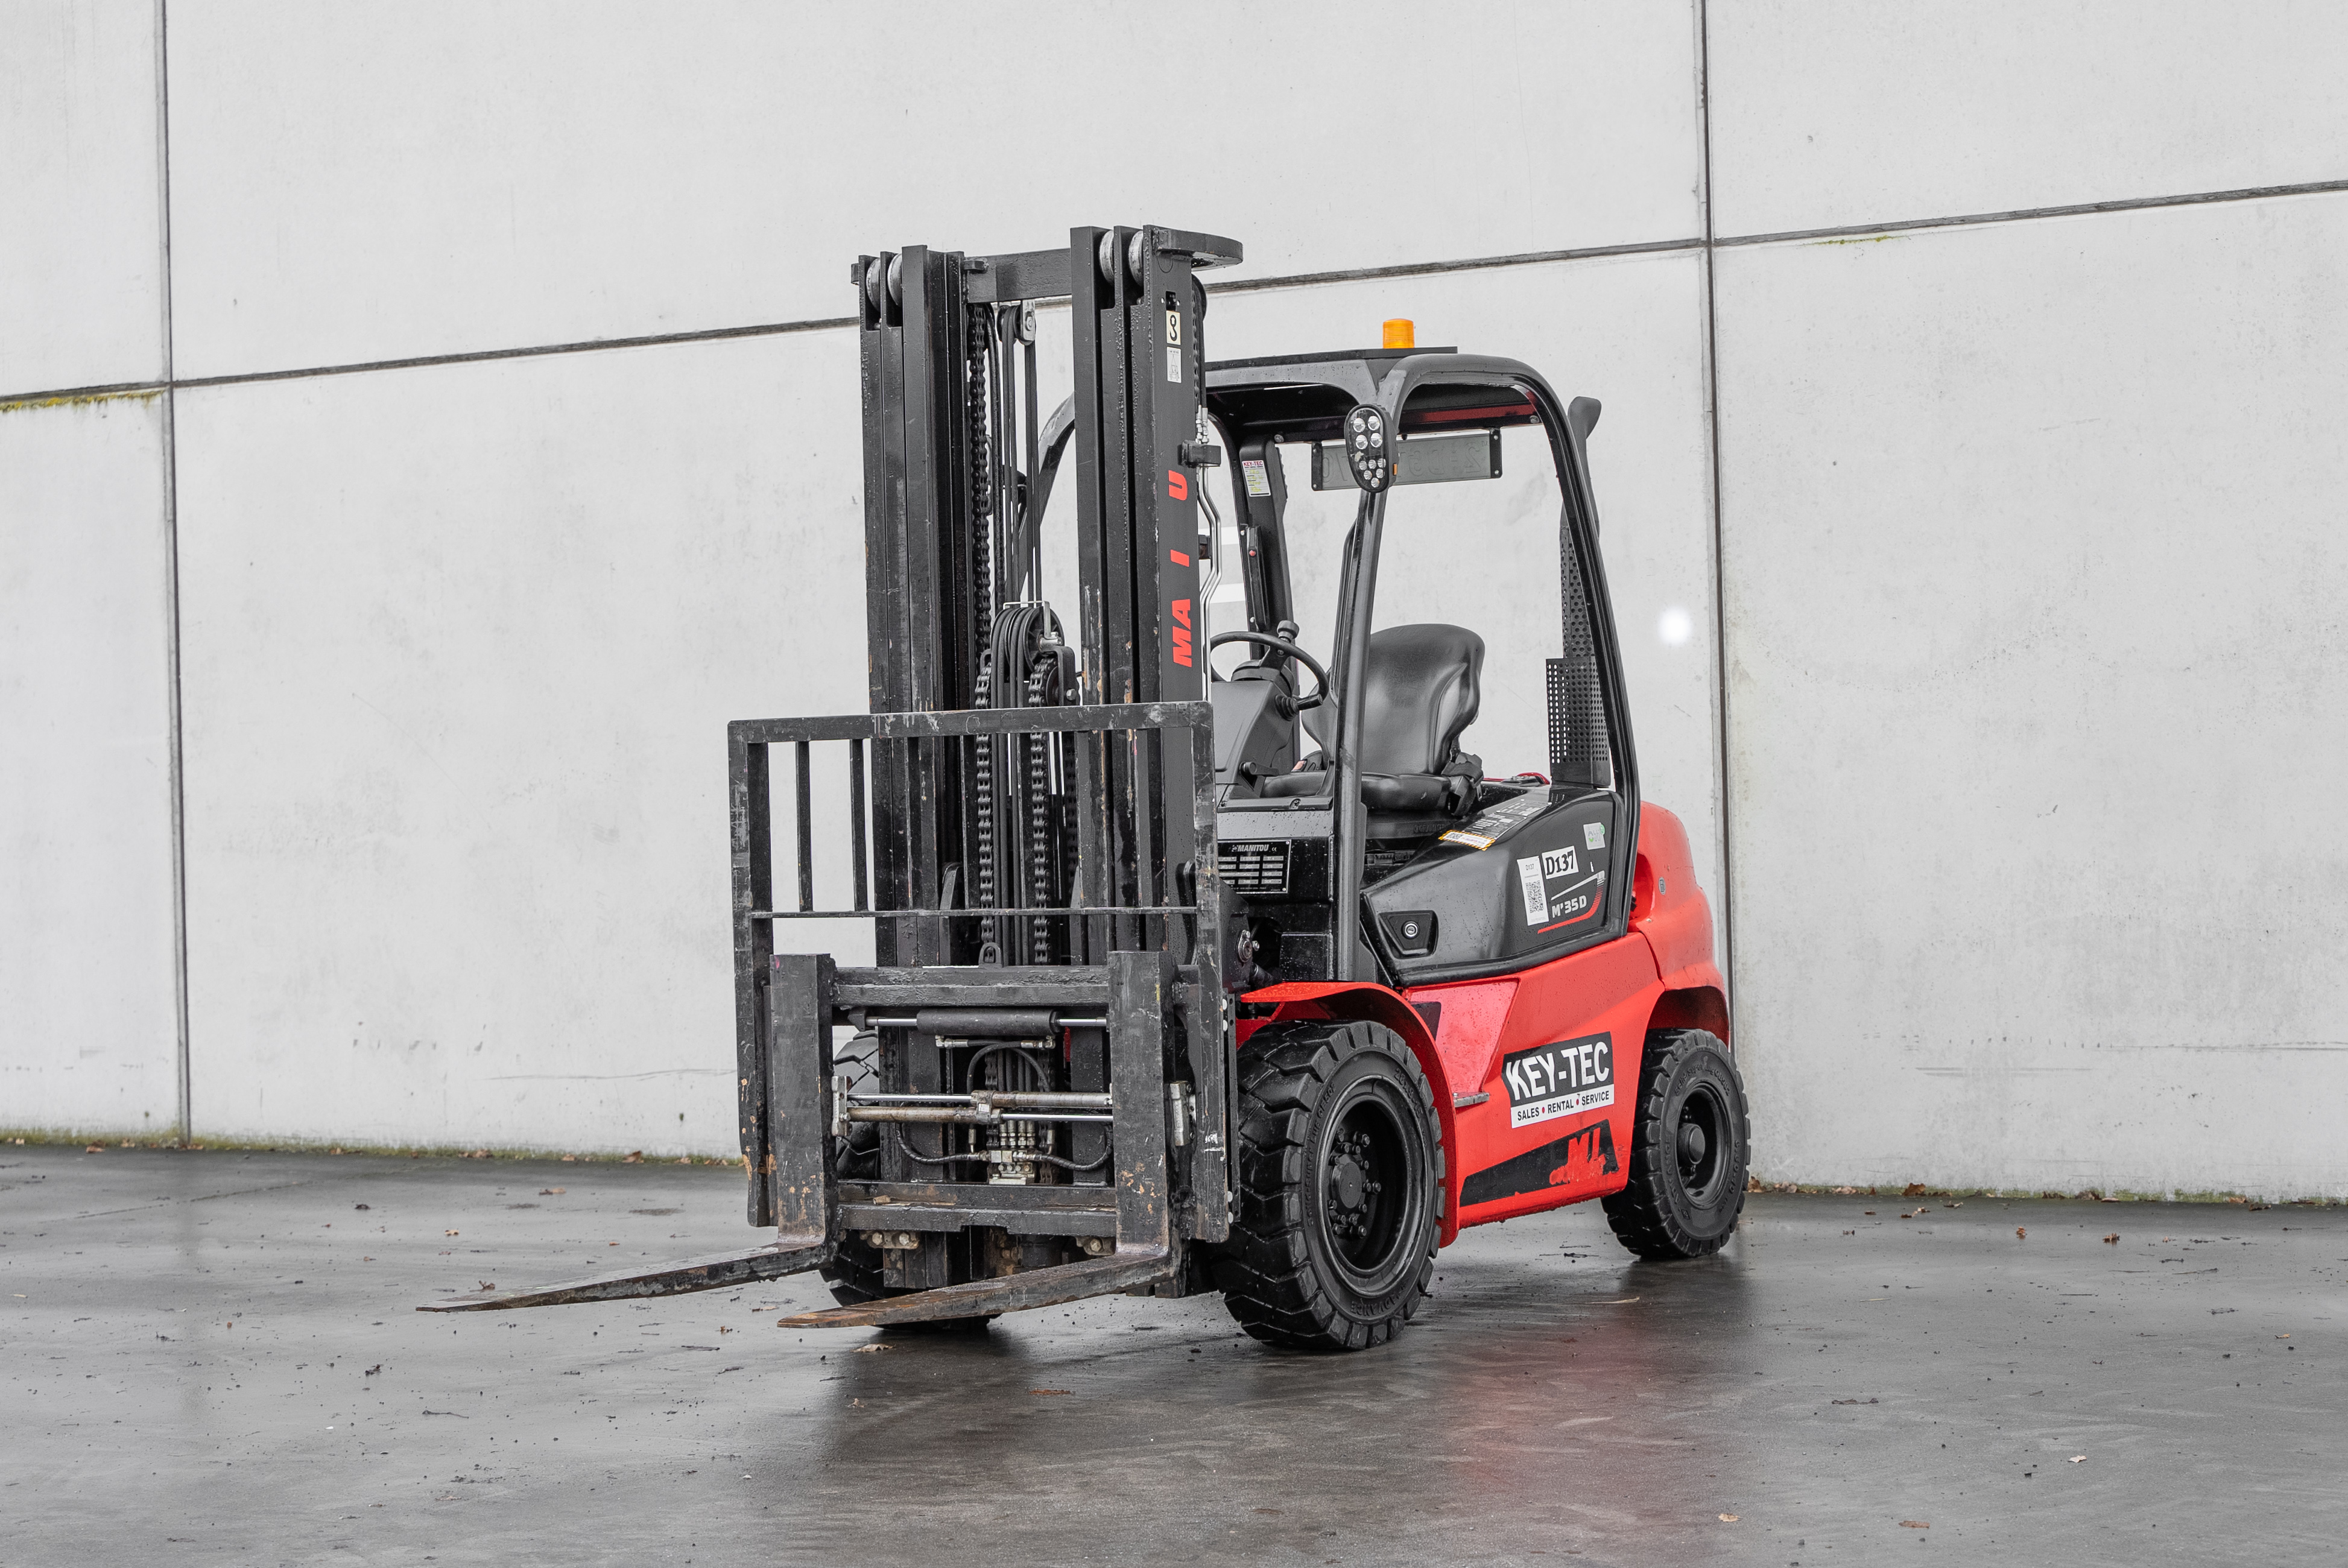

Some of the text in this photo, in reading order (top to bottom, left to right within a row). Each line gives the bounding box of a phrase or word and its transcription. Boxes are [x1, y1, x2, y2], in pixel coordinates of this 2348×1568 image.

[1545, 850, 1575, 876] D137
[1506, 1042, 1609, 1101] KEY-TEC
[1517, 1090, 1609, 1121] SALES RENTAL SERVICE
